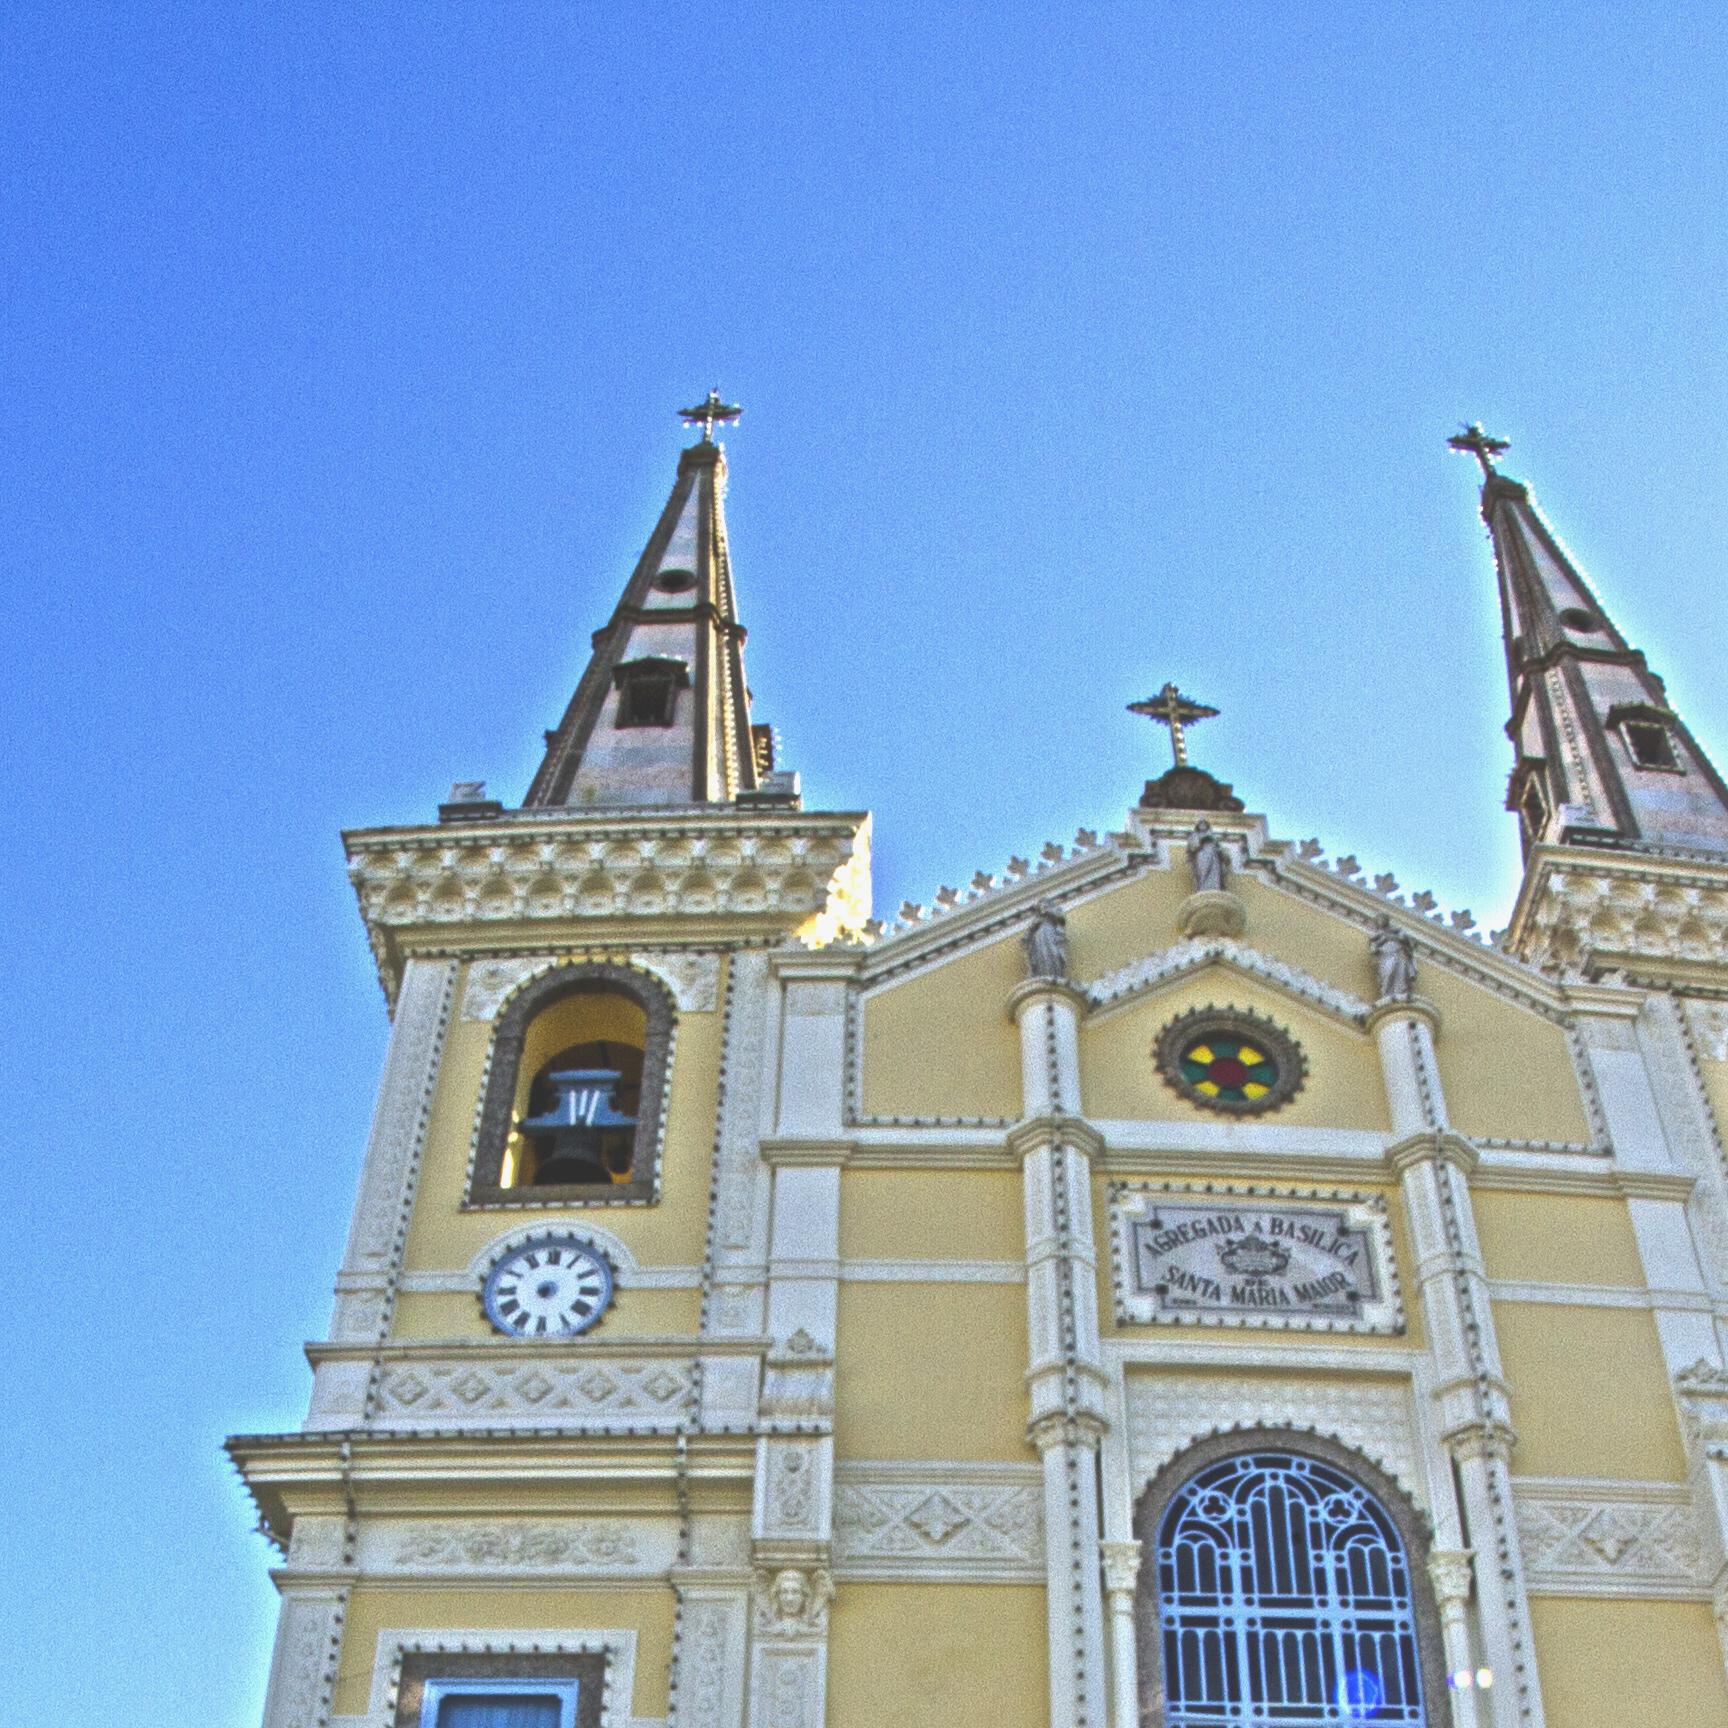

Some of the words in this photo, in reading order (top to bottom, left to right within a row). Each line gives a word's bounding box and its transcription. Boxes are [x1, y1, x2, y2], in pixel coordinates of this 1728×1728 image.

[1144, 1215, 1245, 1259] AGREGADA
[1162, 1265, 1221, 1301] SANTA
[1231, 1285, 1290, 1306] MARIA
[1294, 1271, 1351, 1301] MAIOR
